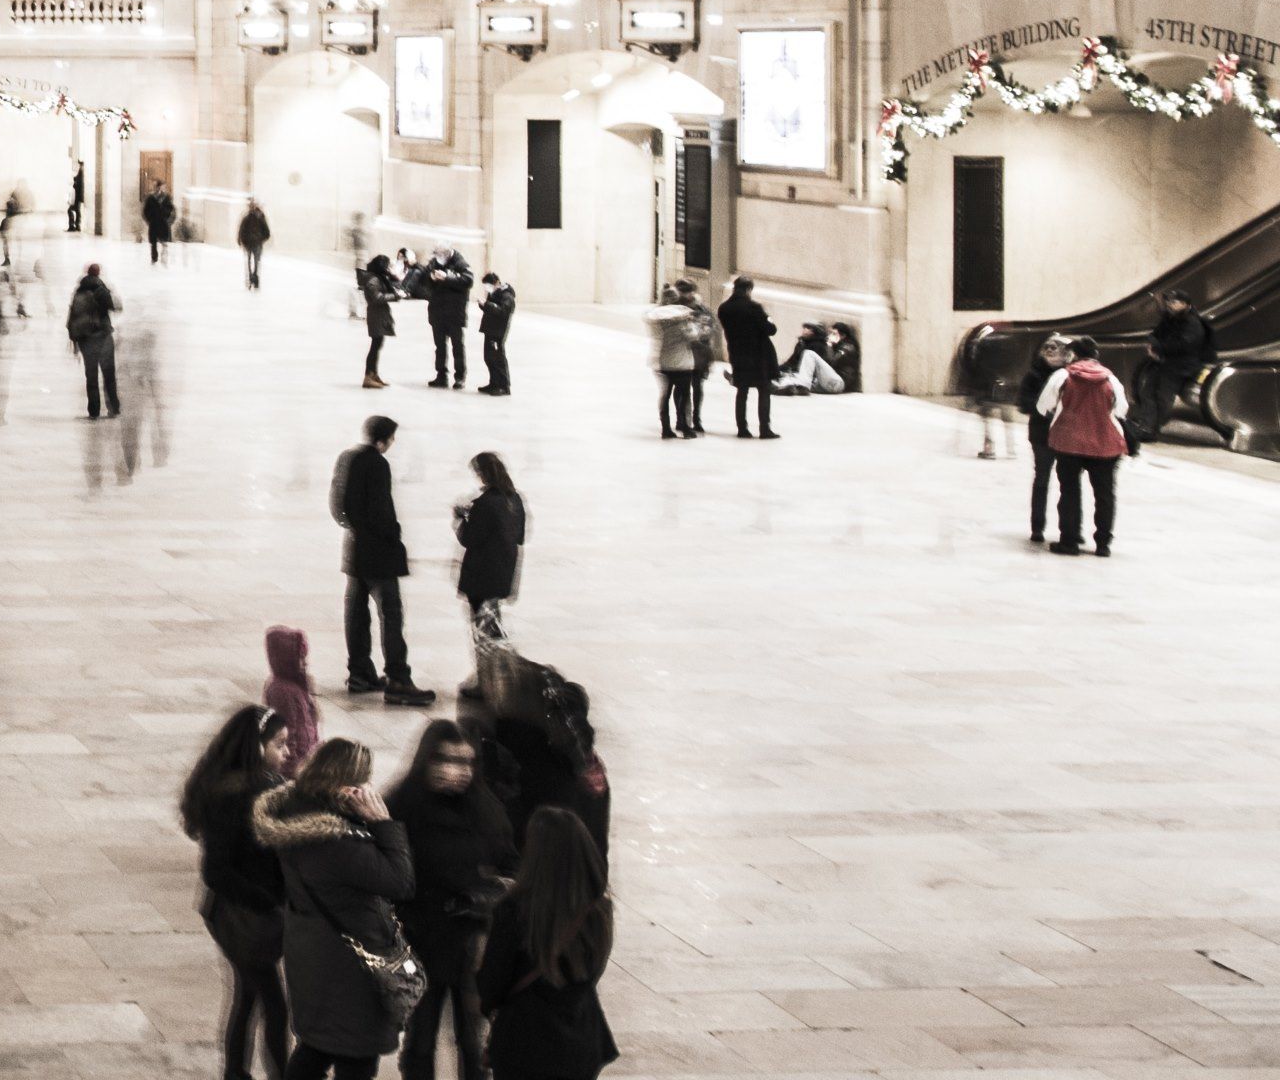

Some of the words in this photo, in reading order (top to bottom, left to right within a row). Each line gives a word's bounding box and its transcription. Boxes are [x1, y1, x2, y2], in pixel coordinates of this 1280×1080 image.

[902, 67, 932, 95] THE
[1001, 17, 1081, 51] BUILDING
[1145, 18, 1195, 45] 45TH
[1200, 24, 1280, 65] STREET
